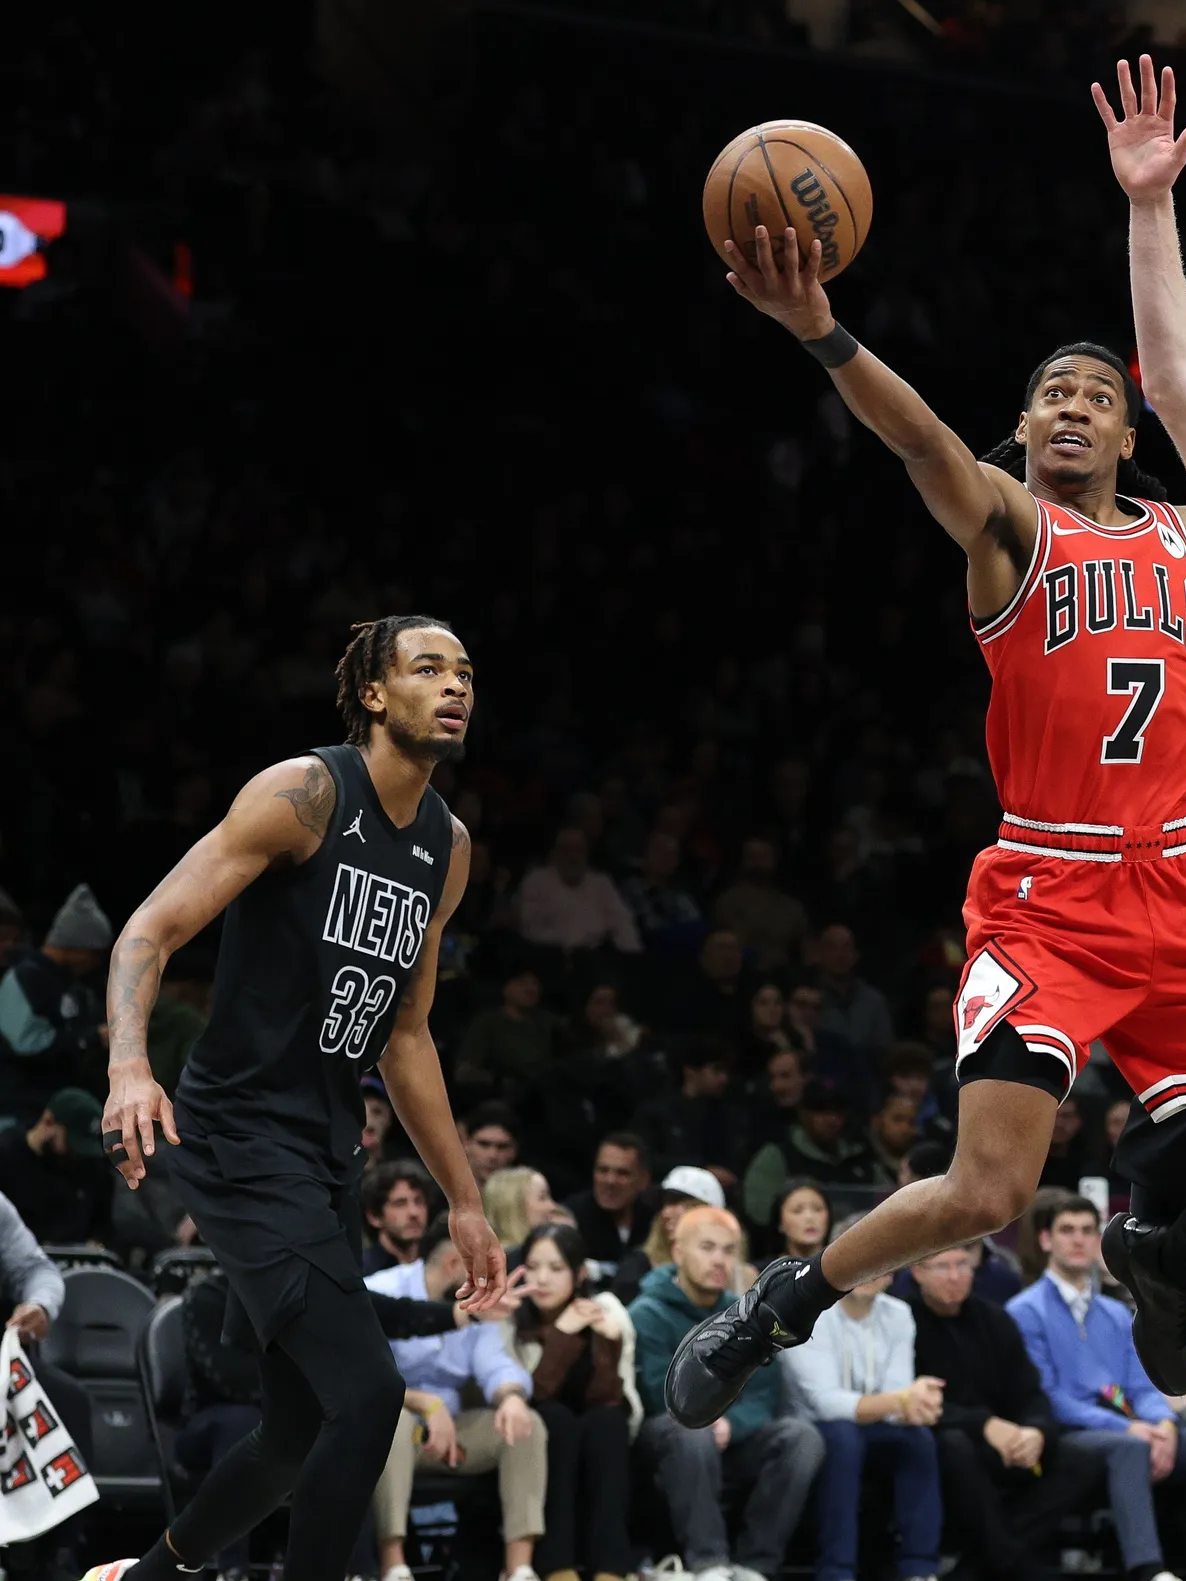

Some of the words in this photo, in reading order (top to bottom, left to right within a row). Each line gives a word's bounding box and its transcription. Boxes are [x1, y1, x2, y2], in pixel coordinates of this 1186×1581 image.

[790, 167, 841, 272] Wilson
[1100, 657, 1166, 764] 7
[322, 862, 431, 970] NETS
[319, 965, 397, 1059] 33
